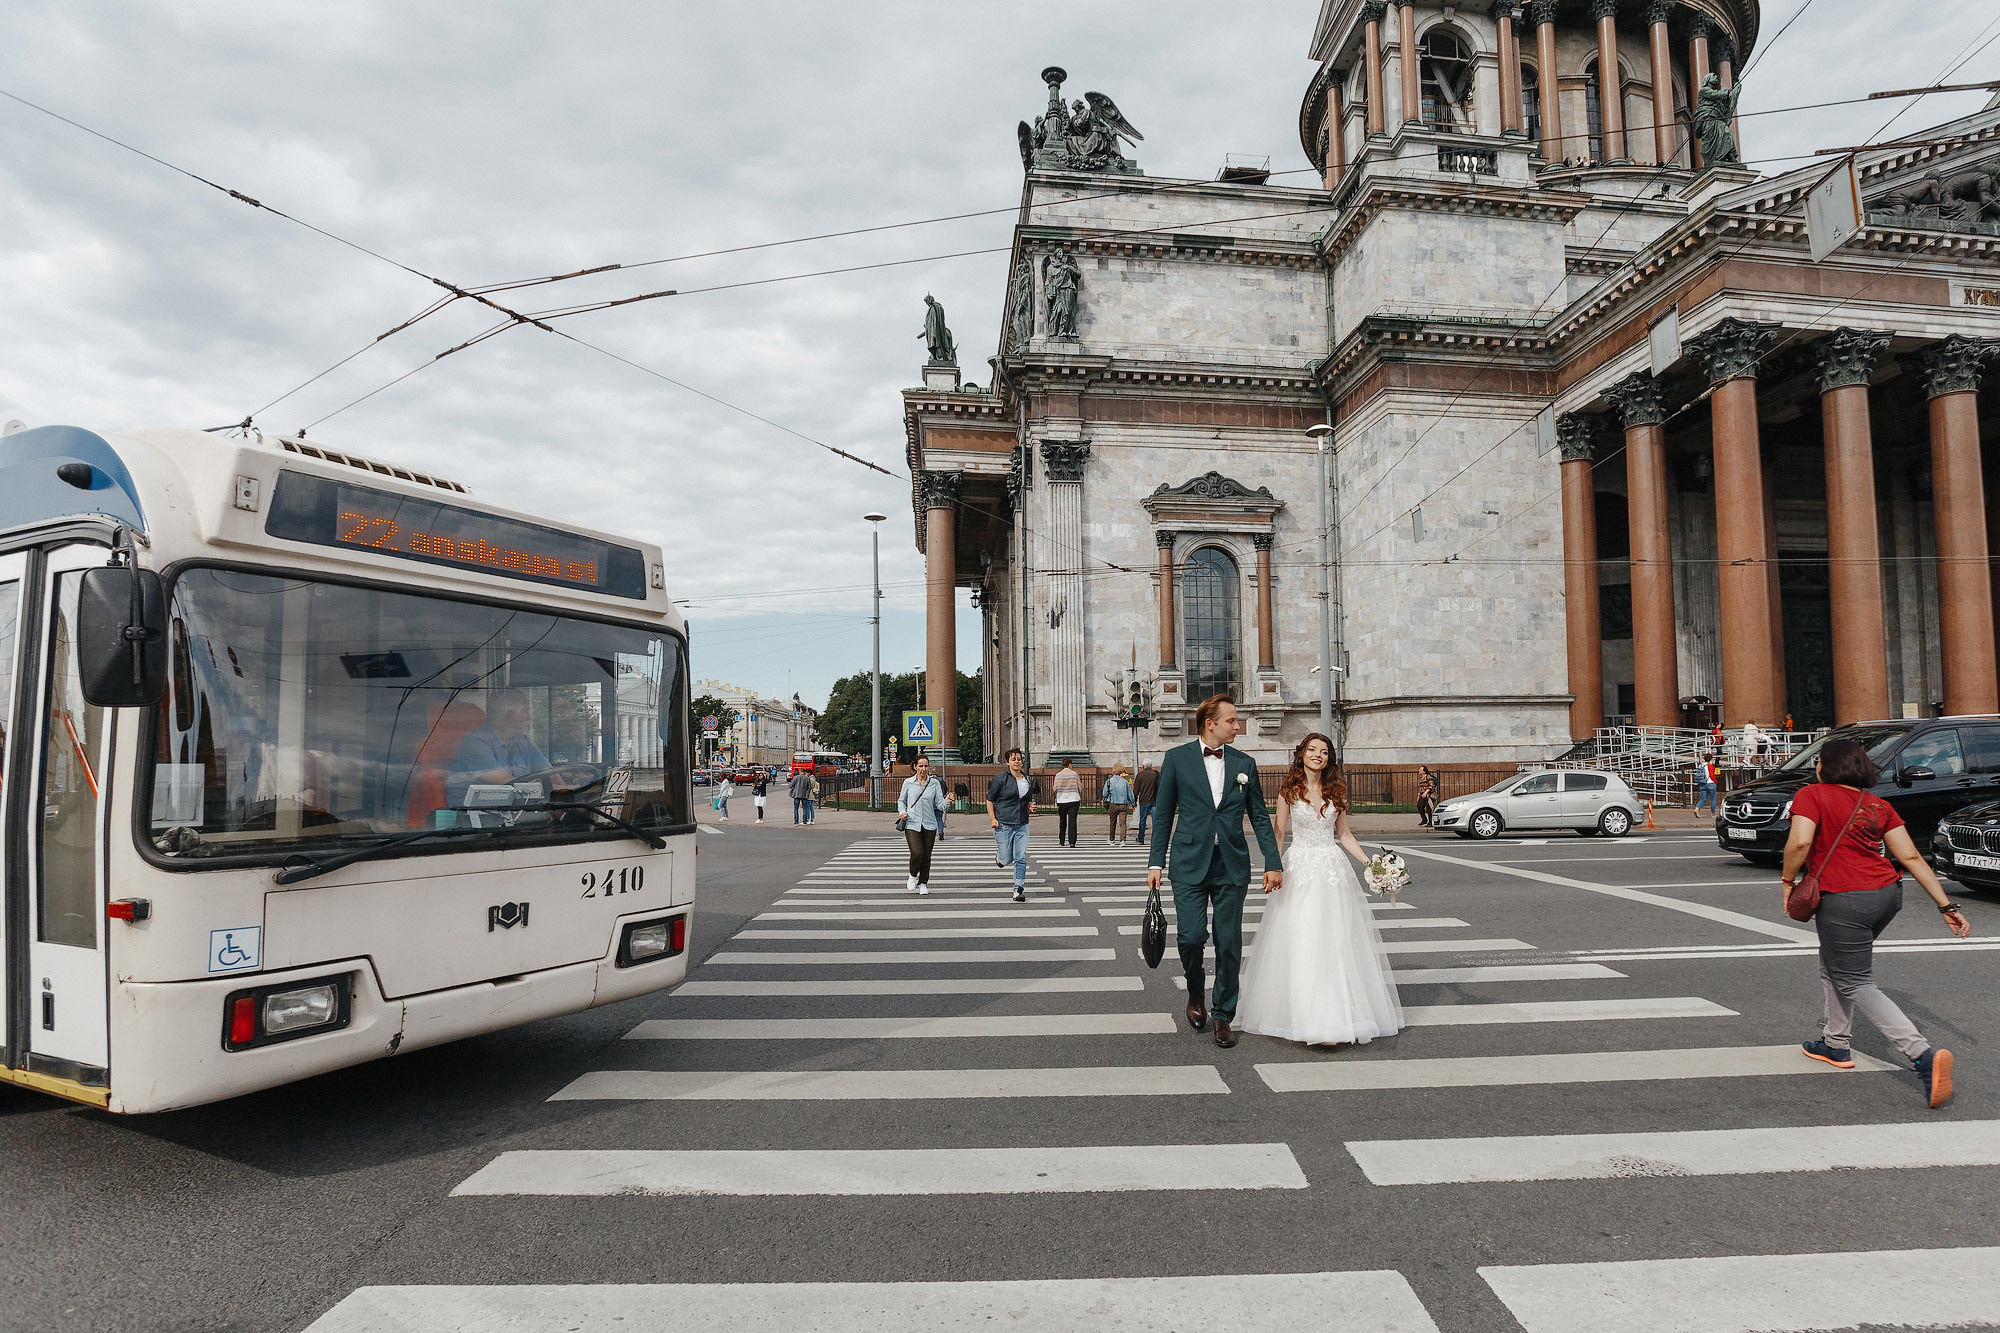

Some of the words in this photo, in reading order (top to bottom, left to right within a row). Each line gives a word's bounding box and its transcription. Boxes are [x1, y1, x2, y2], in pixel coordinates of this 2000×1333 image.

[341, 511, 399, 551] 22
[409, 532, 560, 575] anskaya
[566, 560, 597, 582] st
[608, 770, 630, 793] 22
[580, 865, 644, 899] 2410
